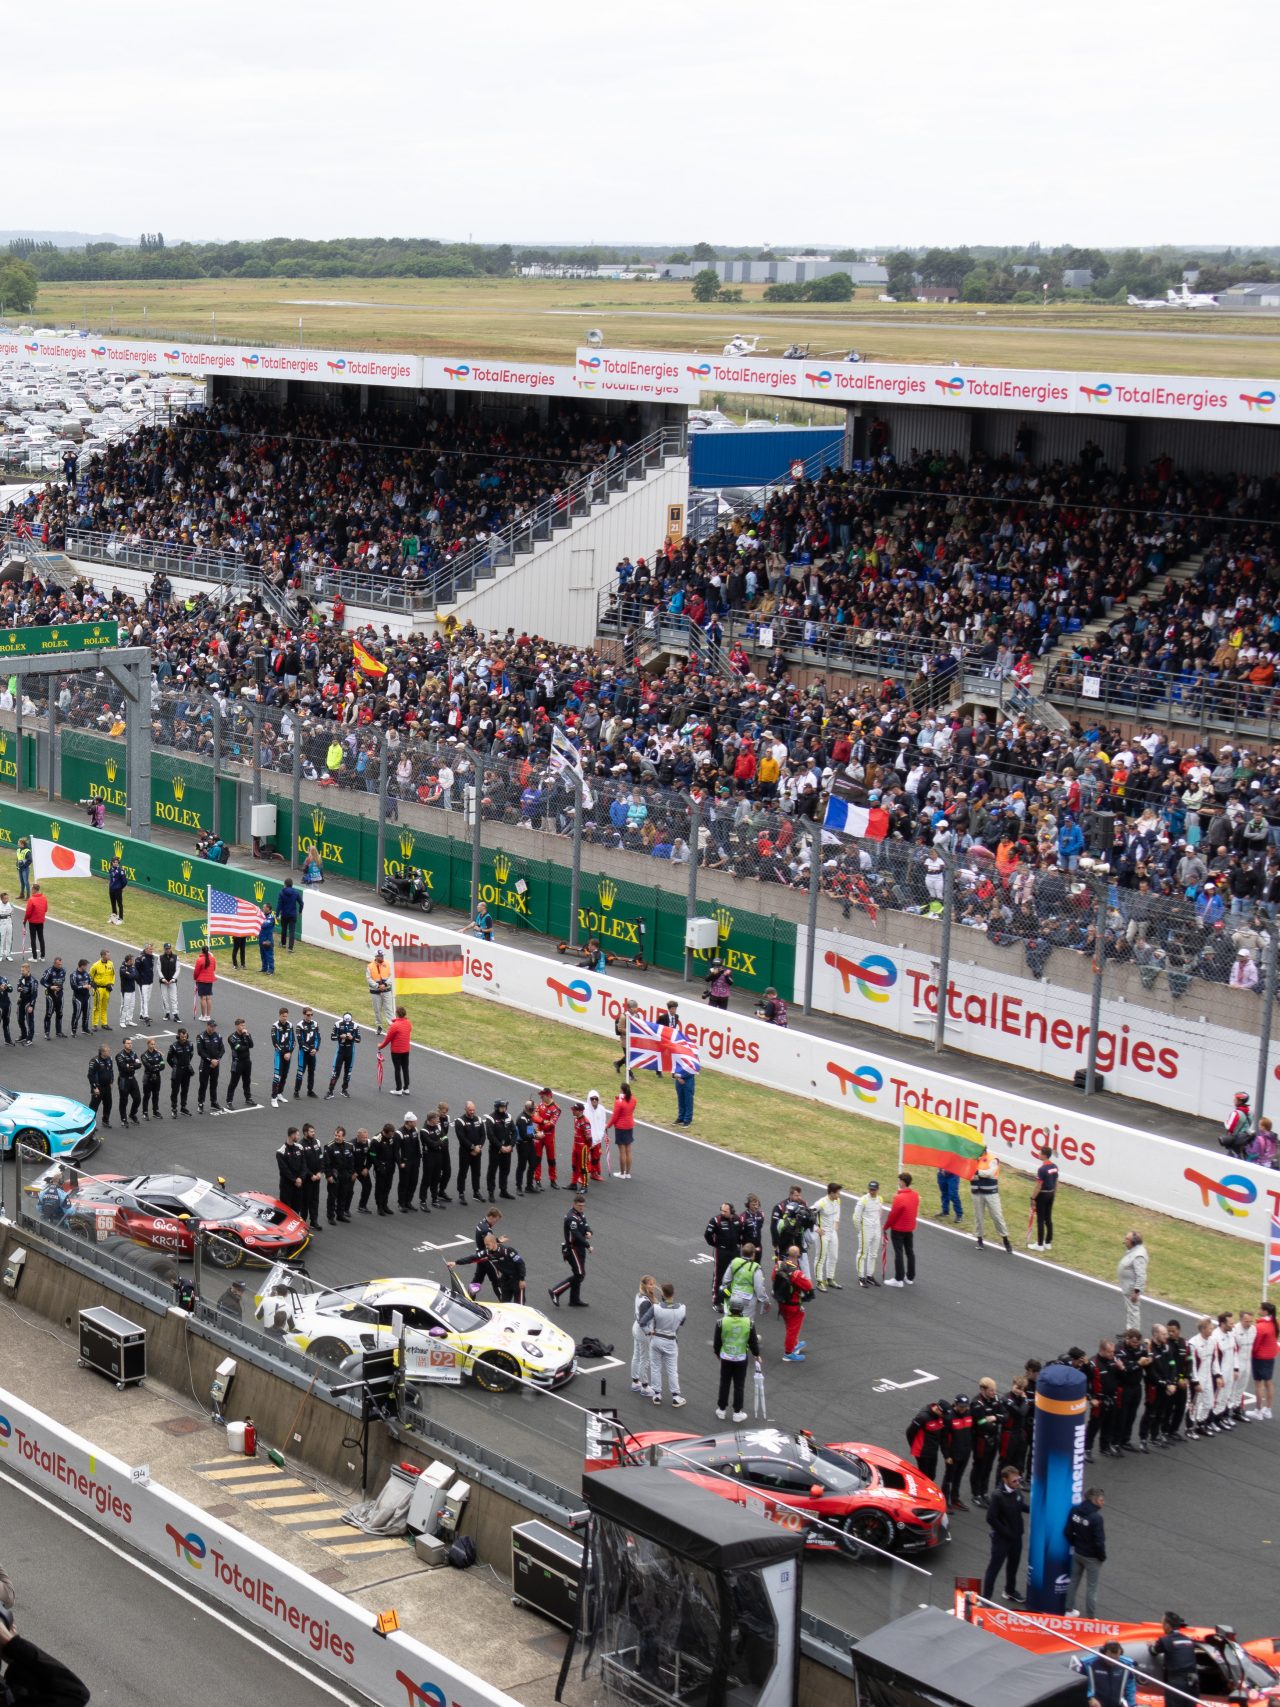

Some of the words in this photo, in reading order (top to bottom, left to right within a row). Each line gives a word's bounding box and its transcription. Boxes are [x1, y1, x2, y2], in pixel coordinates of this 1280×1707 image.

[39, 344, 86, 360] TotalEnergies
[106, 348, 157, 365] TotalEnergies
[181, 352, 235, 368] TotalEnergies
[260, 355, 318, 373] TotalEnergies
[347, 361, 411, 379] TotalEnergies
[602, 359, 679, 379] TotalEnergies
[472, 367, 555, 387] TotalEnergies
[713, 366, 797, 388] TotalEnergies
[834, 373, 926, 396] TotalEnergies
[967, 380, 1068, 403] TotalEnergies
[1115, 387, 1228, 411] TotalEnergies
[0, 643, 26, 652] ROLEX
[42, 639, 68, 649] ROLEX
[83, 636, 110, 645] ROLEX
[155, 801, 201, 829] ROLEX
[167, 879, 206, 903] ROLEX
[906, 968, 1179, 1080] TotalEnergies
[890, 1077, 1096, 1167] TotalEnergies
[97, 1216, 114, 1231] 66
[152, 1234, 188, 1249] KROLL
[432, 1351, 454, 1367] 92
[15, 1427, 133, 1524] TotalEnergies
[133, 1469, 146, 1479] 94
[778, 1511, 801, 1531] 70
[210, 1550, 355, 1665] TotalEnergies
[994, 1613, 1121, 1636] CROWDSTRIKE
